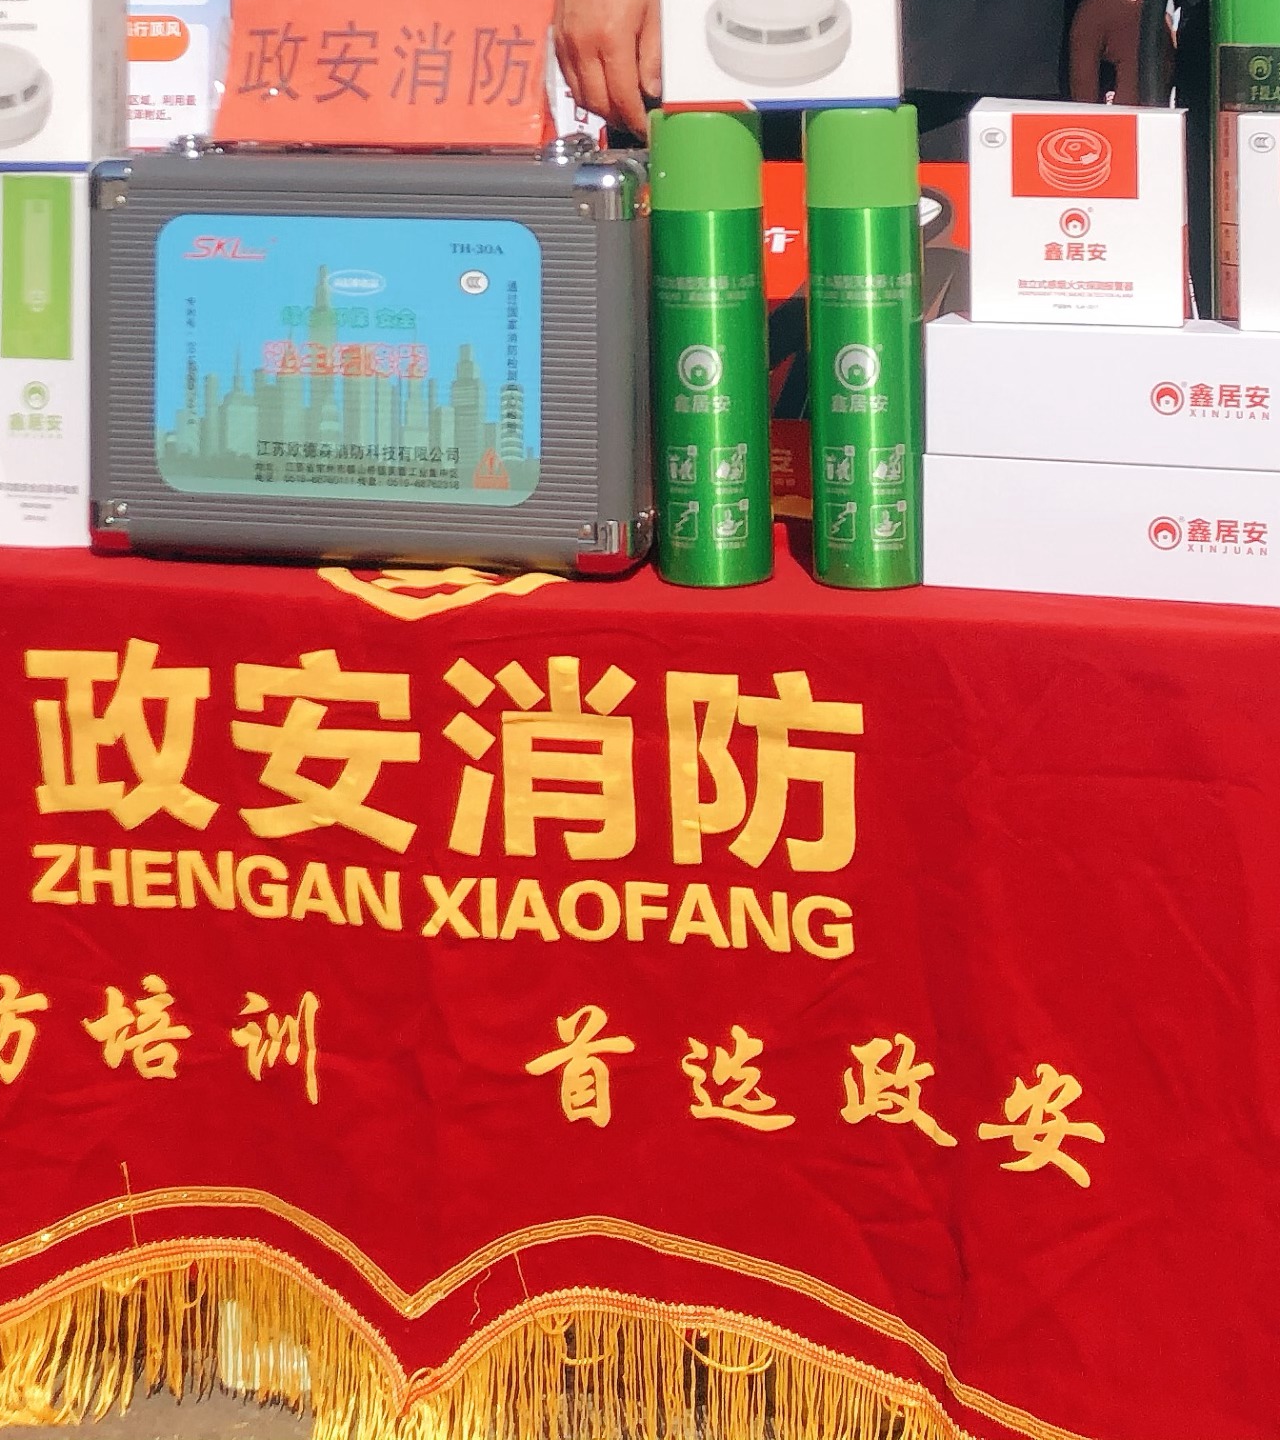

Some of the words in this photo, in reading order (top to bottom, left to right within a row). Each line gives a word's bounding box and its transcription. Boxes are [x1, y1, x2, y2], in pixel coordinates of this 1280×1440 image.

[238, 21, 536, 106] 政安消防
[450, 242, 504, 255] TH-30A
[1044, 241, 1107, 262] 鑫居安
[1189, 383, 1271, 410] 鑫居安
[1189, 409, 1271, 420] XINJUAN
[1186, 518, 1268, 545] 鑫居安
[1186, 544, 1268, 556] XINJUAN
[24, 637, 865, 873] 政安消防
[31, 844, 402, 933] ZHENGAN
[420, 875, 855, 961] XIAOFANG
[525, 1004, 1107, 1189] 首选政安
